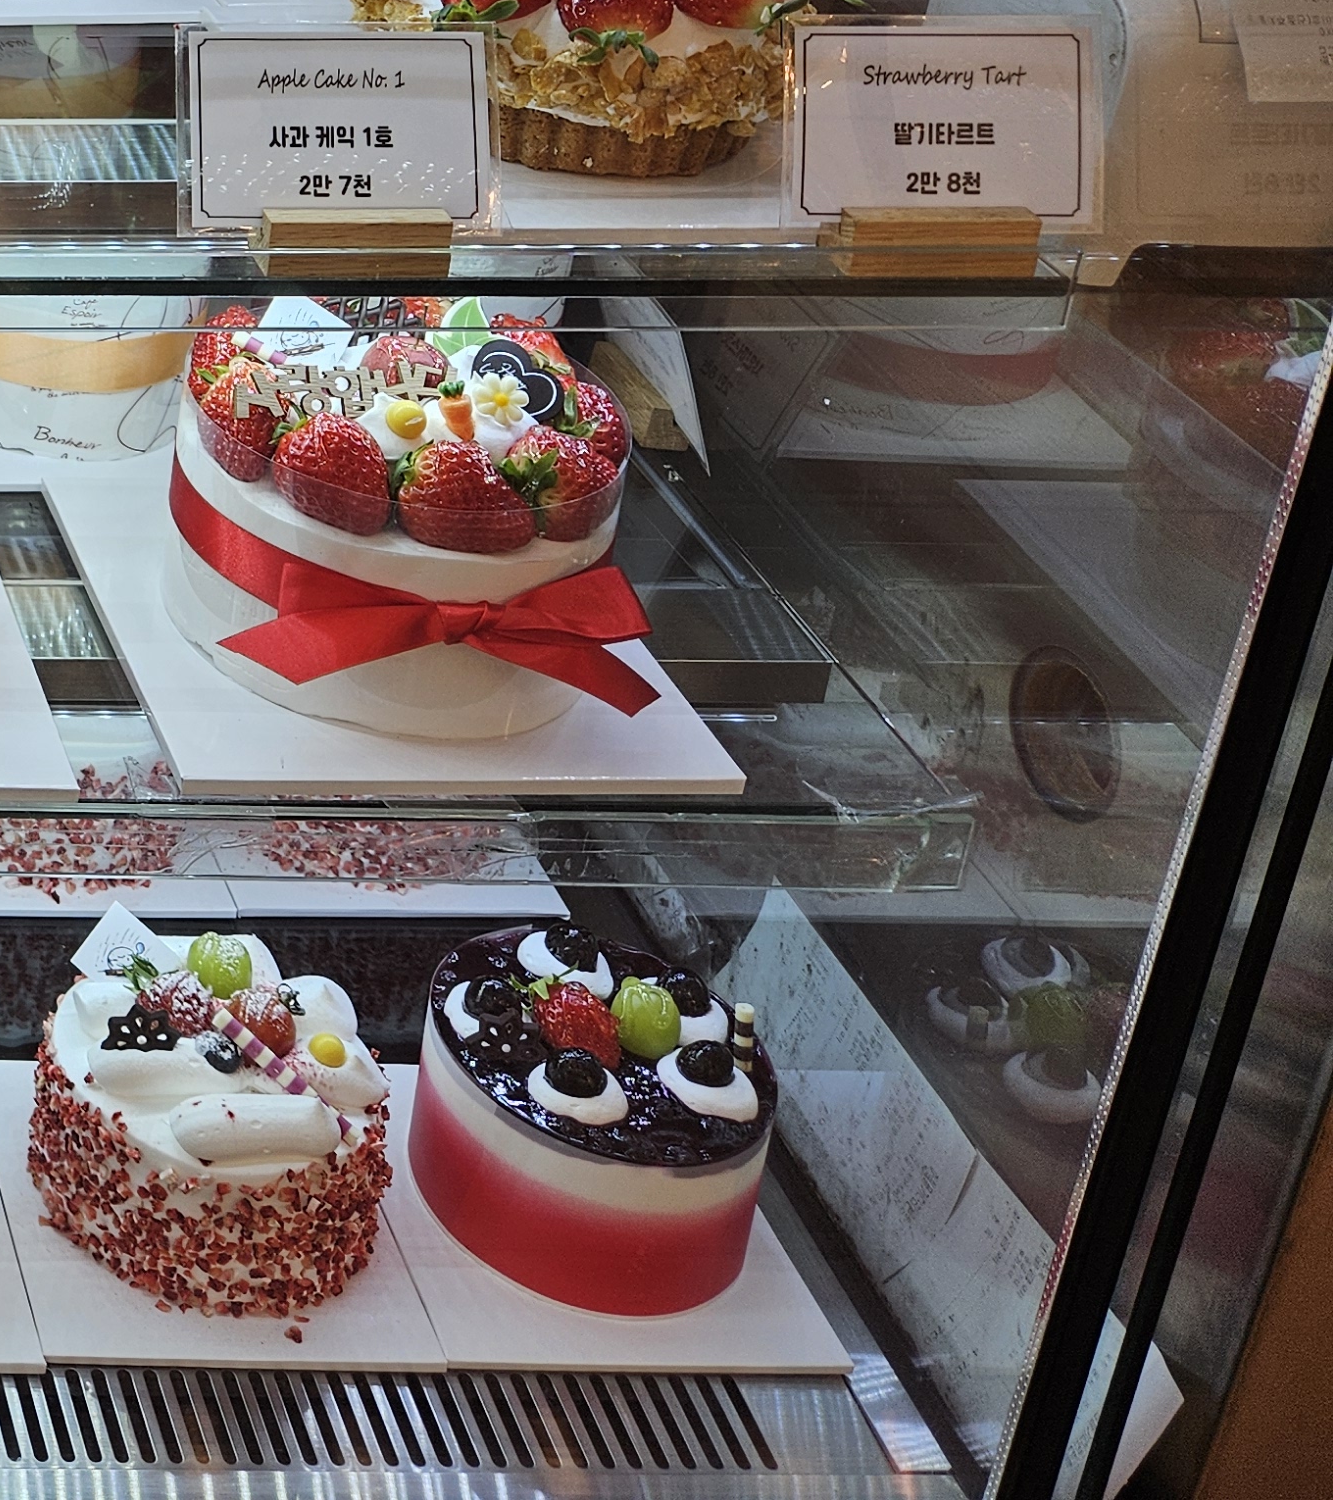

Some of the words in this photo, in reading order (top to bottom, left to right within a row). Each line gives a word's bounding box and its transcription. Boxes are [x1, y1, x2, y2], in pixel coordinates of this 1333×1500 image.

[257, 68, 312, 95] Apple
[313, 68, 360, 89] Cake
[361, 66, 389, 89] No.
[394, 69, 406, 89] 1
[862, 63, 974, 91] Strawberry
[980, 64, 1028, 87] Tart
[268, 124, 311, 149] 사과
[314, 124, 355, 149] 케익
[362, 124, 395, 149] 1호
[893, 121, 996, 146] 딸기타르트
[298, 173, 334, 198] 2만
[338, 173, 373, 198] 7천
[905, 171, 941, 195] 2만
[946, 171, 982, 195] 8천
[61, 305, 103, 320] Espoir
[33, 425, 103, 450] Bonheur
